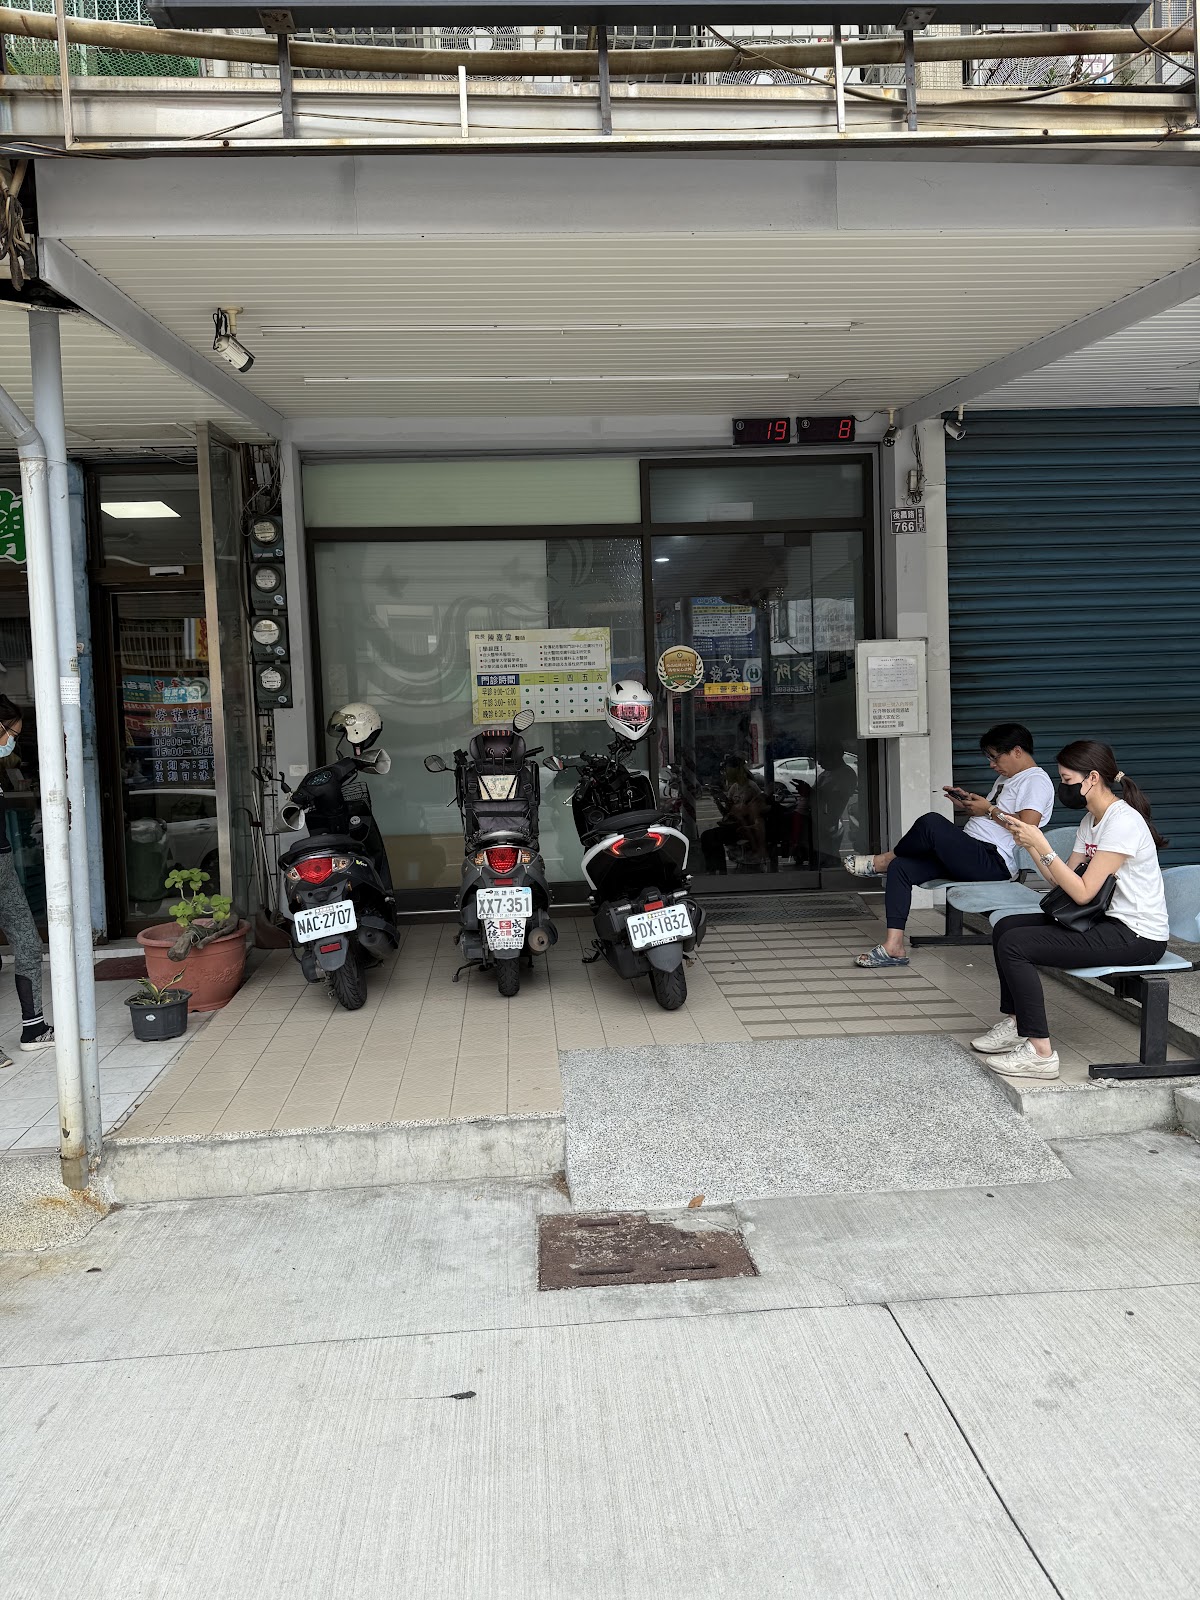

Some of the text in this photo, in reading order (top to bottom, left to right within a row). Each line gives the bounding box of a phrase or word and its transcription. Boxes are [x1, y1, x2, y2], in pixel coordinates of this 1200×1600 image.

[767, 420, 787, 441] 19
[838, 420, 851, 439] 8
[894, 522, 914, 532] 766
[481, 675, 516, 685] 門診時間
